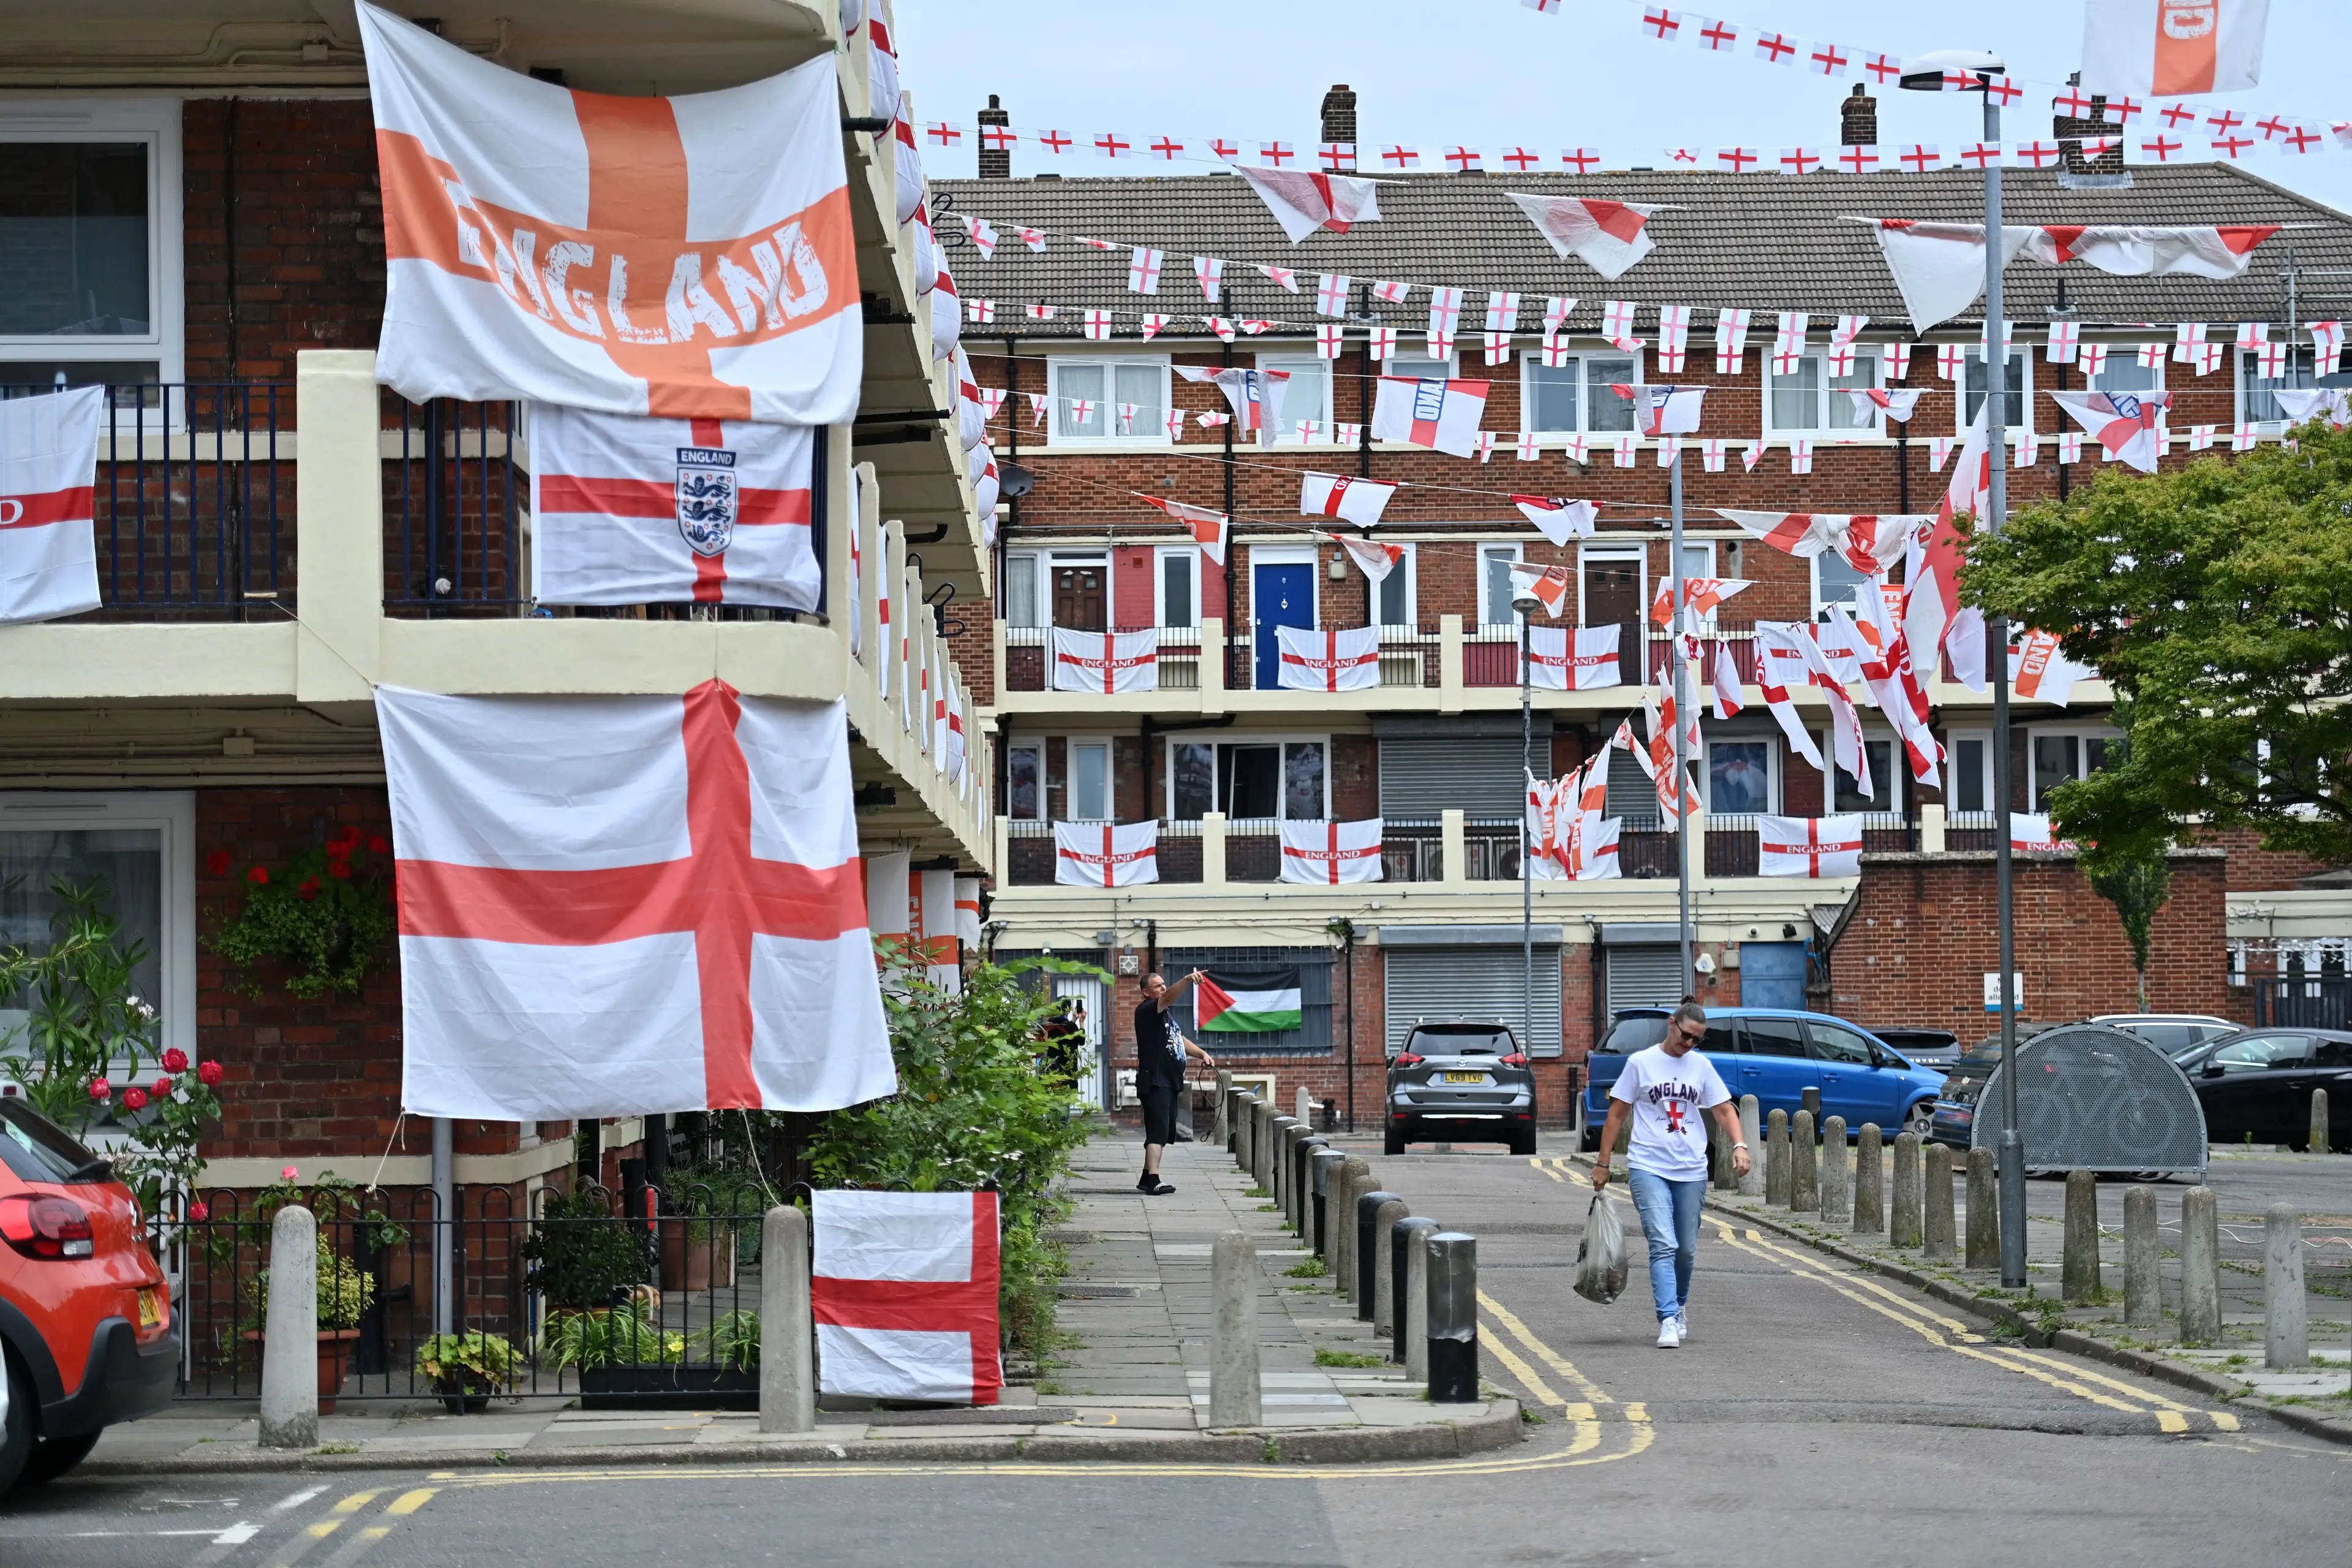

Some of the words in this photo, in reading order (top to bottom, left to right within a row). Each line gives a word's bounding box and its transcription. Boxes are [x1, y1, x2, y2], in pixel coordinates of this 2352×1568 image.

[440, 177, 828, 345] ENGLAND
[680, 450, 732, 465] ENGLAND
[1081, 658, 1136, 668] ENGLAND
[1304, 658, 1359, 668] ENGLAND
[1543, 657, 1598, 666] ENGLAND
[1786, 843, 1841, 854] ENGLAND
[1080, 853, 1136, 864] ENGLAND
[1305, 850, 1361, 860] ENGLAND
[1445, 1072, 1465, 1081] LV69
